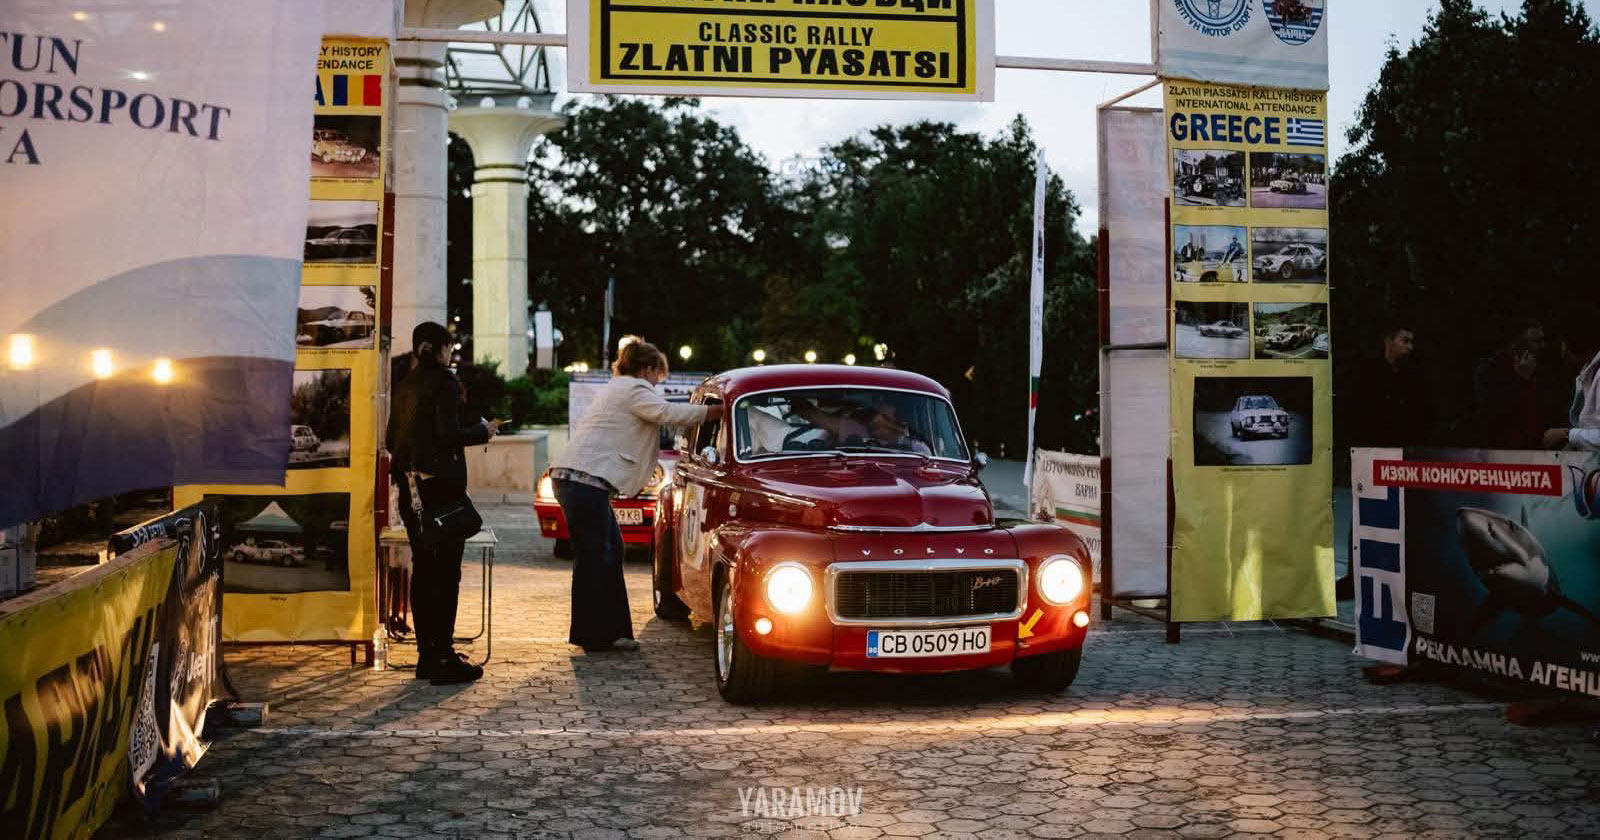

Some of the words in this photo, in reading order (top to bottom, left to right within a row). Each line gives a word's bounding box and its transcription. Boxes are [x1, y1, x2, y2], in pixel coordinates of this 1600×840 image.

[699, 21, 797, 45] CLASSIC
[807, 25, 874, 47] RALLY
[1202, 26, 1231, 37] МОТОР
[1233, 6, 1253, 31] СПОРТ
[332, 46, 382, 57] HISTORY
[618, 42, 753, 73] ZLATNI
[768, 46, 950, 79] PYASATSI
[1169, 86, 1201, 97] ZLATNI
[1203, 87, 1250, 100] PIASSATSI
[1252, 90, 1282, 102] RALLY
[1285, 92, 1324, 104] HISTORY
[1176, 98, 1251, 112] INTERNATIONAL
[1254, 102, 1317, 115] ATTENDANCE
[1170, 112, 1281, 145] GREECE
[0, 126, 42, 165] A
[1380, 465, 1419, 481] ИЗЯЖ
[1421, 466, 1553, 490] КОНКУРЕНЦИЯТА
[862, 546, 995, 556] VOLVO
[881, 634, 908, 654] CB
[912, 632, 960, 654] 0509
[962, 630, 987, 651] HO
[1415, 636, 1524, 681] РЕКЛАМНА
